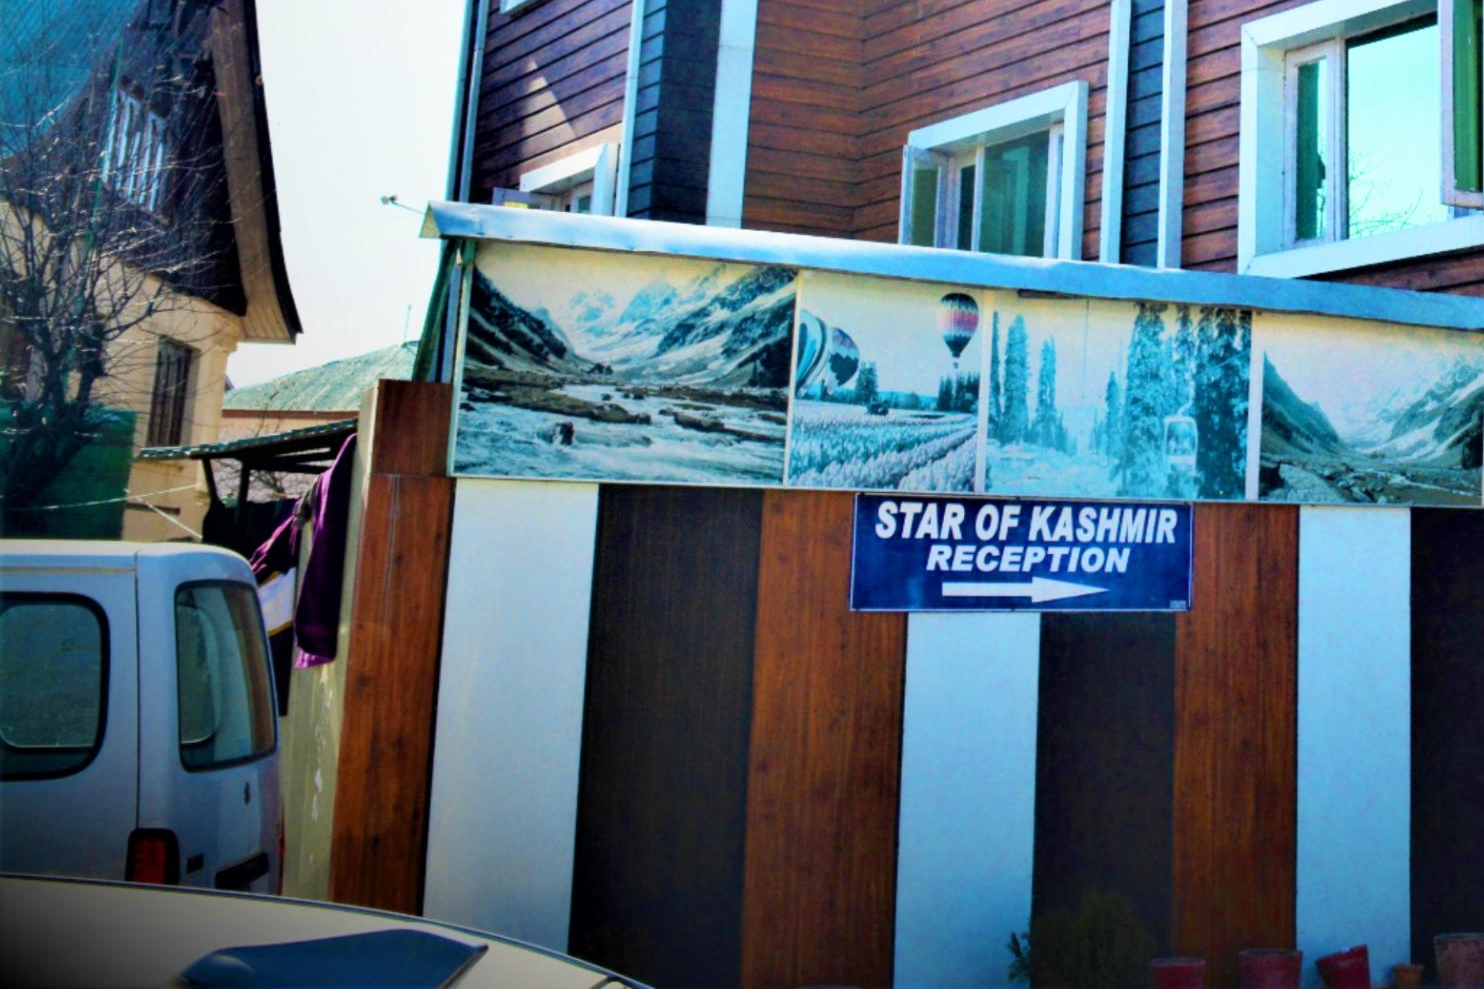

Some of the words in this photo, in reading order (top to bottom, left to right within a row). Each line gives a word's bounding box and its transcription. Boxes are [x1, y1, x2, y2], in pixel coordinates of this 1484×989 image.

[875, 501, 964, 540] STAR
[975, 505, 1021, 540] OF
[1028, 506, 1178, 544] KASHMIR
[926, 545, 1130, 572] RECEPTION
